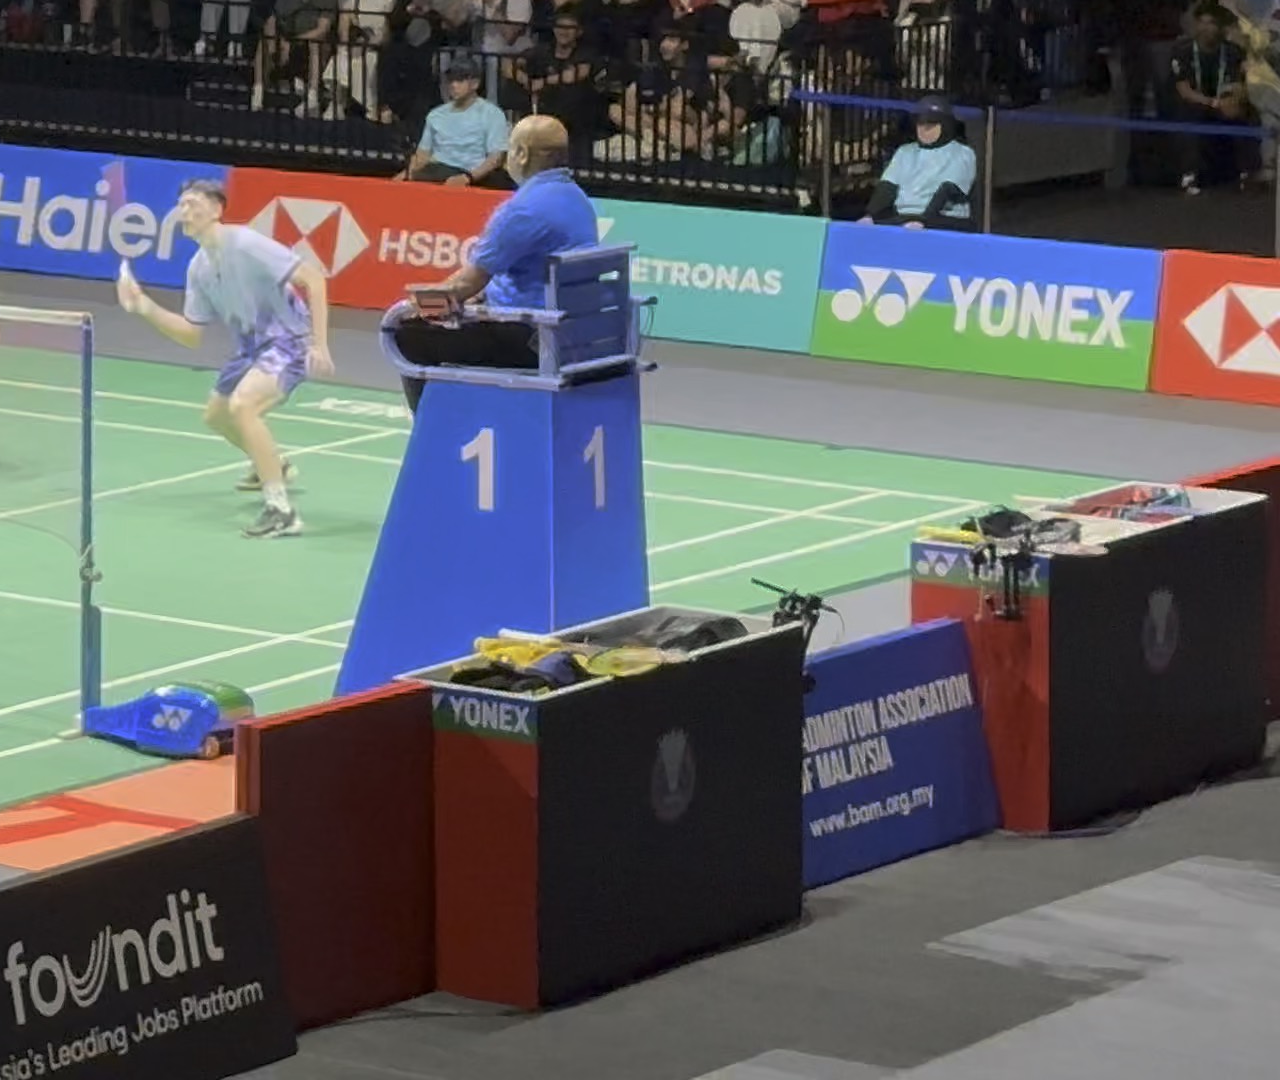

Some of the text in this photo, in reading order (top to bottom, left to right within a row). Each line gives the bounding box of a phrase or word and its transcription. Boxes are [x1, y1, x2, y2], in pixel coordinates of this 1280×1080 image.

[631, 255, 784, 296] ETRONAS
[948, 274, 1135, 349] YONEX
[460, 426, 494, 511] 1
[583, 424, 606, 509] 1
[448, 695, 531, 736] YONEX
[877, 673, 974, 732] ASSOCIATION
[815, 735, 895, 790] MALAYSIA
[808, 784, 934, 838] www.bam.org.my
[3, 888, 225, 1025] foundit
[47, 1023, 130, 1071] Leading
[130, 1006, 180, 1044] Jobs
[181, 980, 265, 1025] Platform
